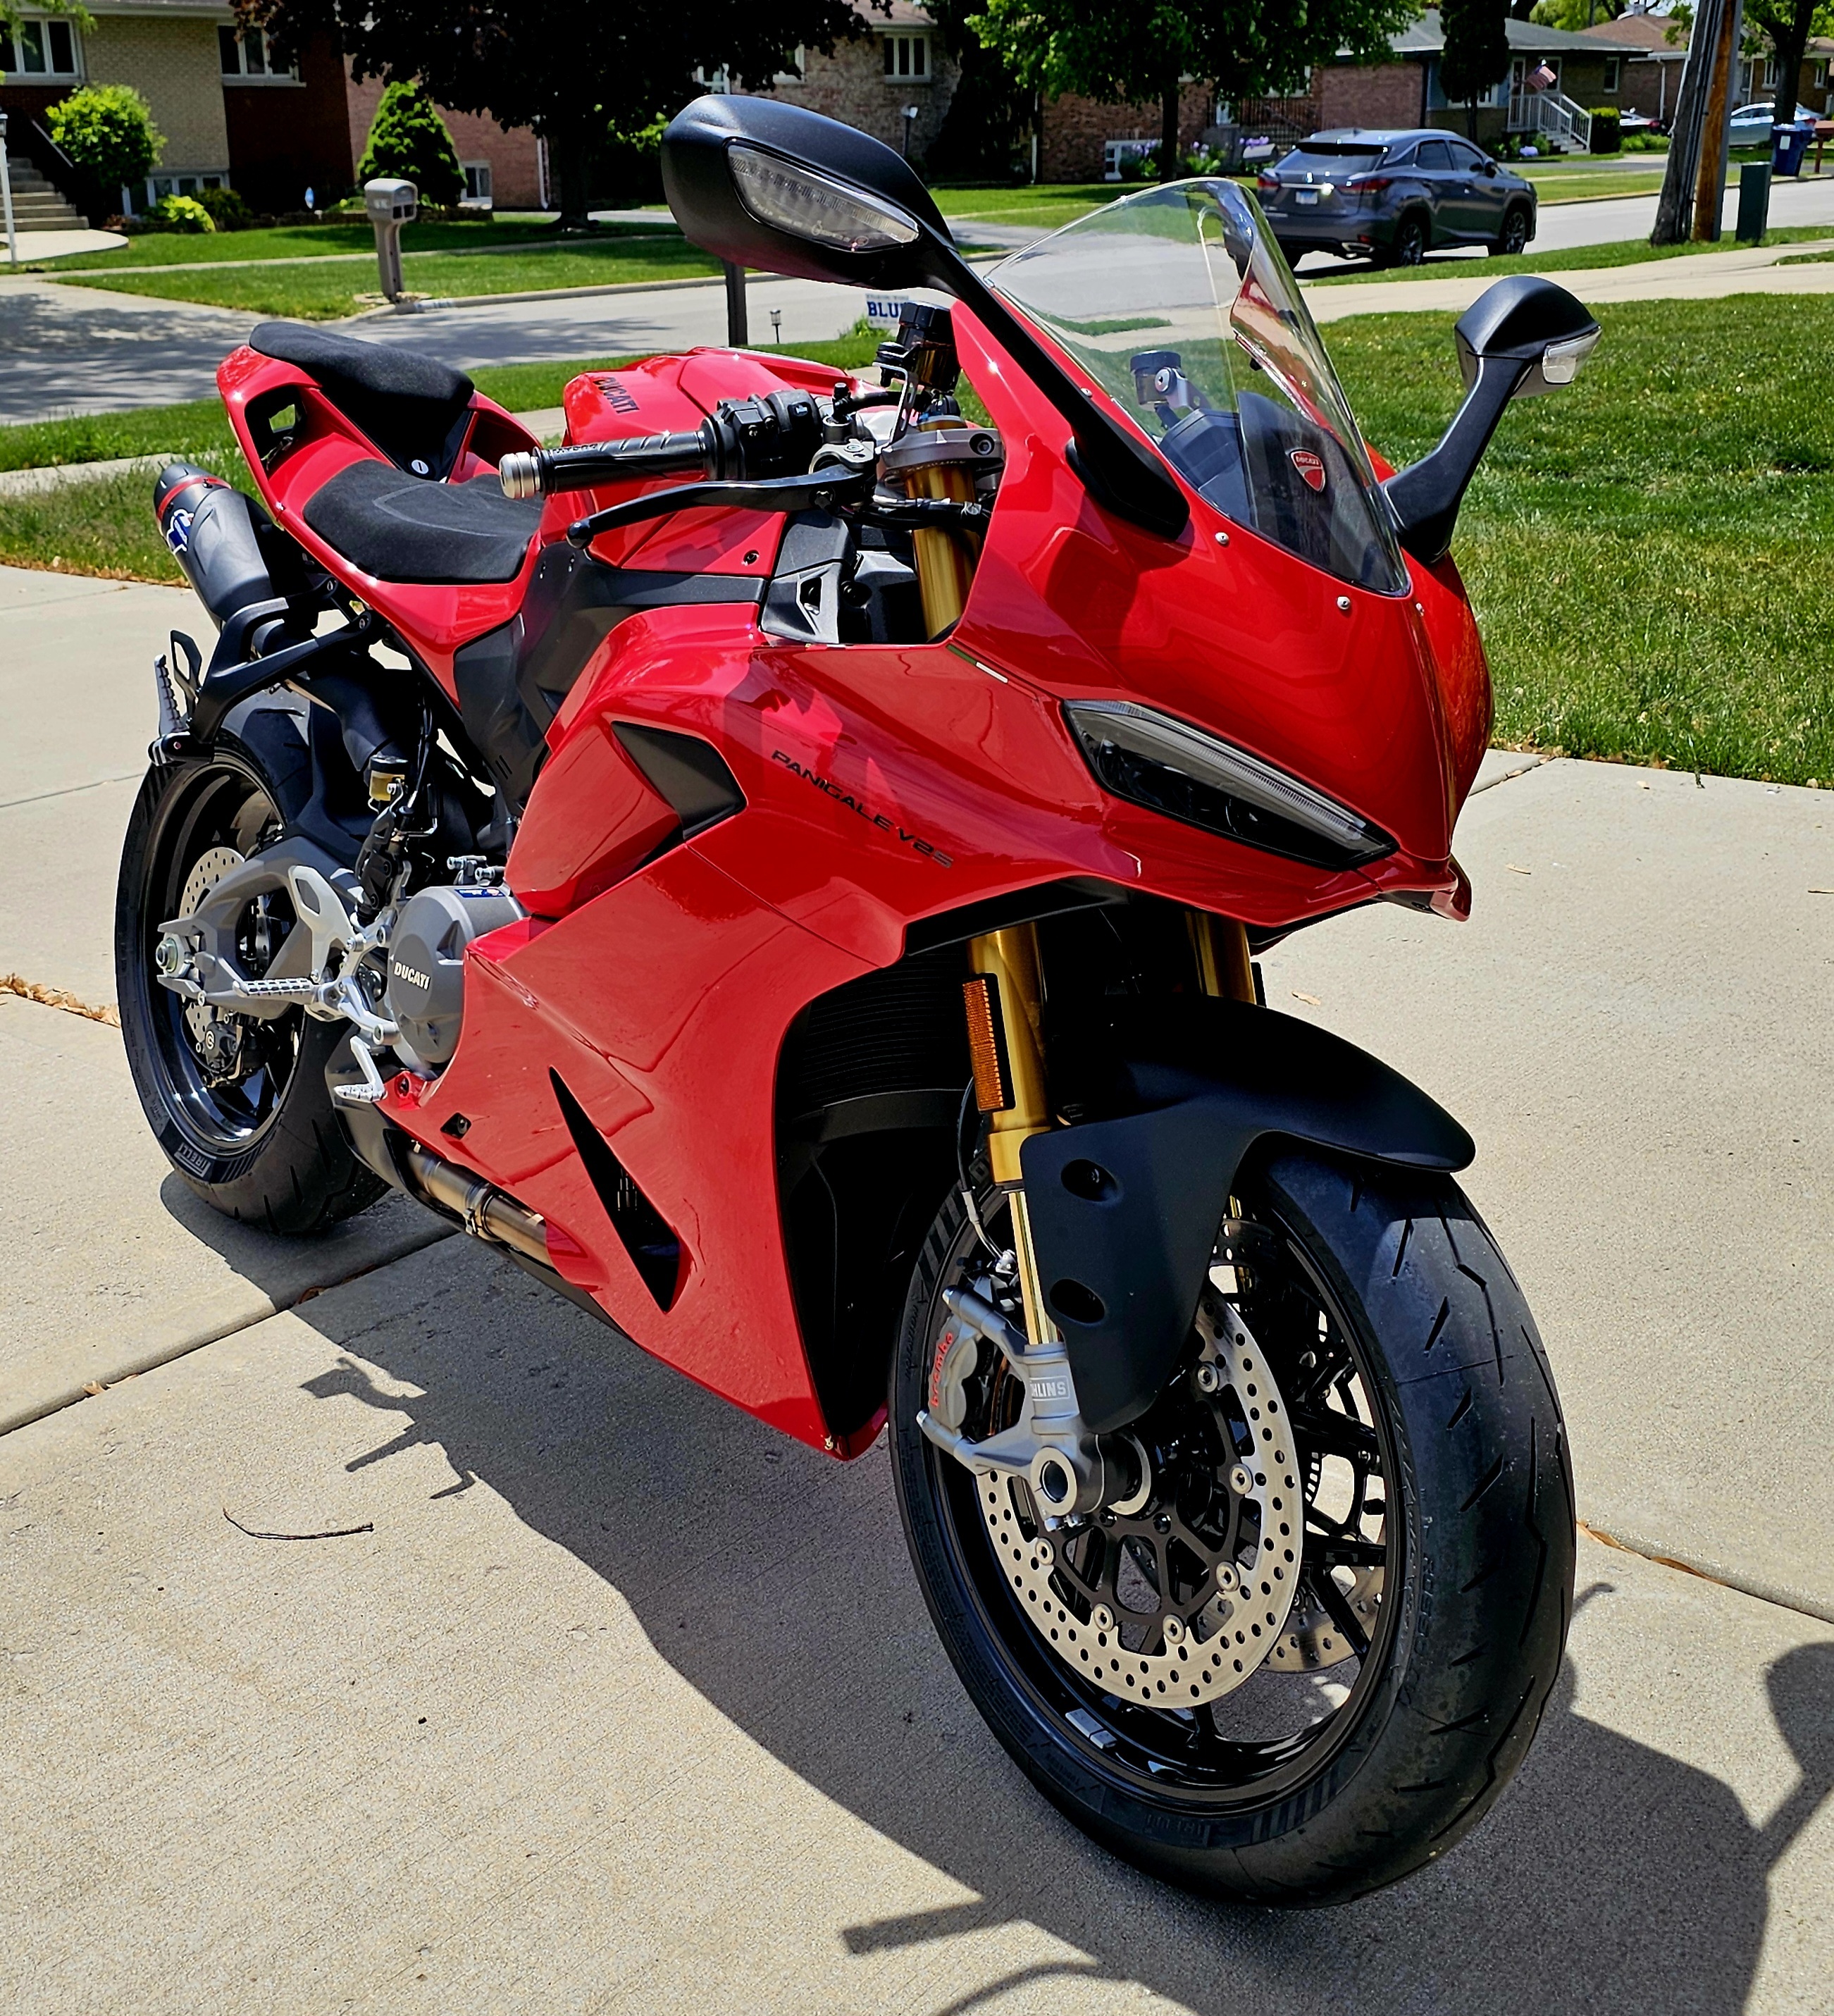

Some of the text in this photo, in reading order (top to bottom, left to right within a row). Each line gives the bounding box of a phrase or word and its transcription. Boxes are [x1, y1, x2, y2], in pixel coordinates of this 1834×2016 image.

[867, 302, 902, 318] BLU
[593, 377, 640, 414] DUCATI
[1295, 456, 1319, 465] DUCATI
[771, 750, 895, 832] PANIGALE
[394, 961, 430, 990] DUCATI
[930, 1330, 954, 1408] brembo
[1029, 1381, 1067, 1397] HLINS
